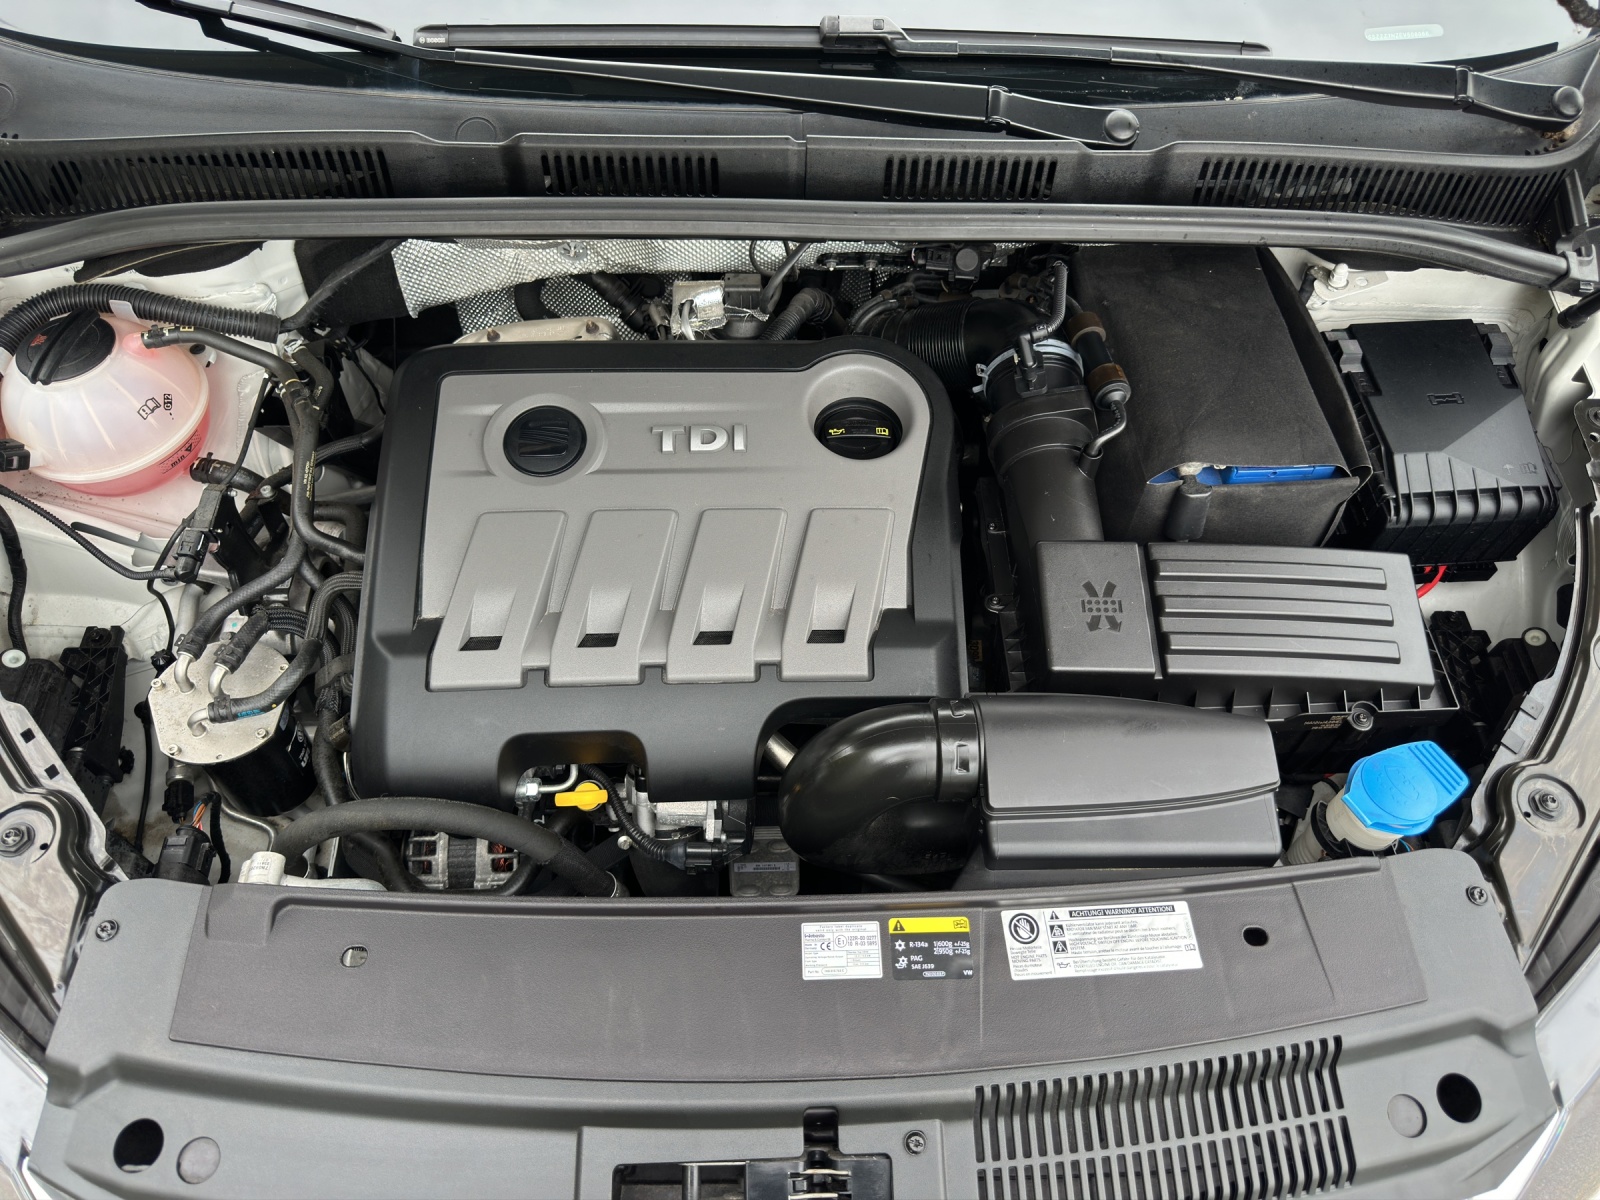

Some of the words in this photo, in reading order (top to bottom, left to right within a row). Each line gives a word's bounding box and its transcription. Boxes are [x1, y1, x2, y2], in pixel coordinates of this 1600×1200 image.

[650, 424, 747, 454] TDI
[170, 454, 186, 468] min
[820, 942, 831, 950] CE
